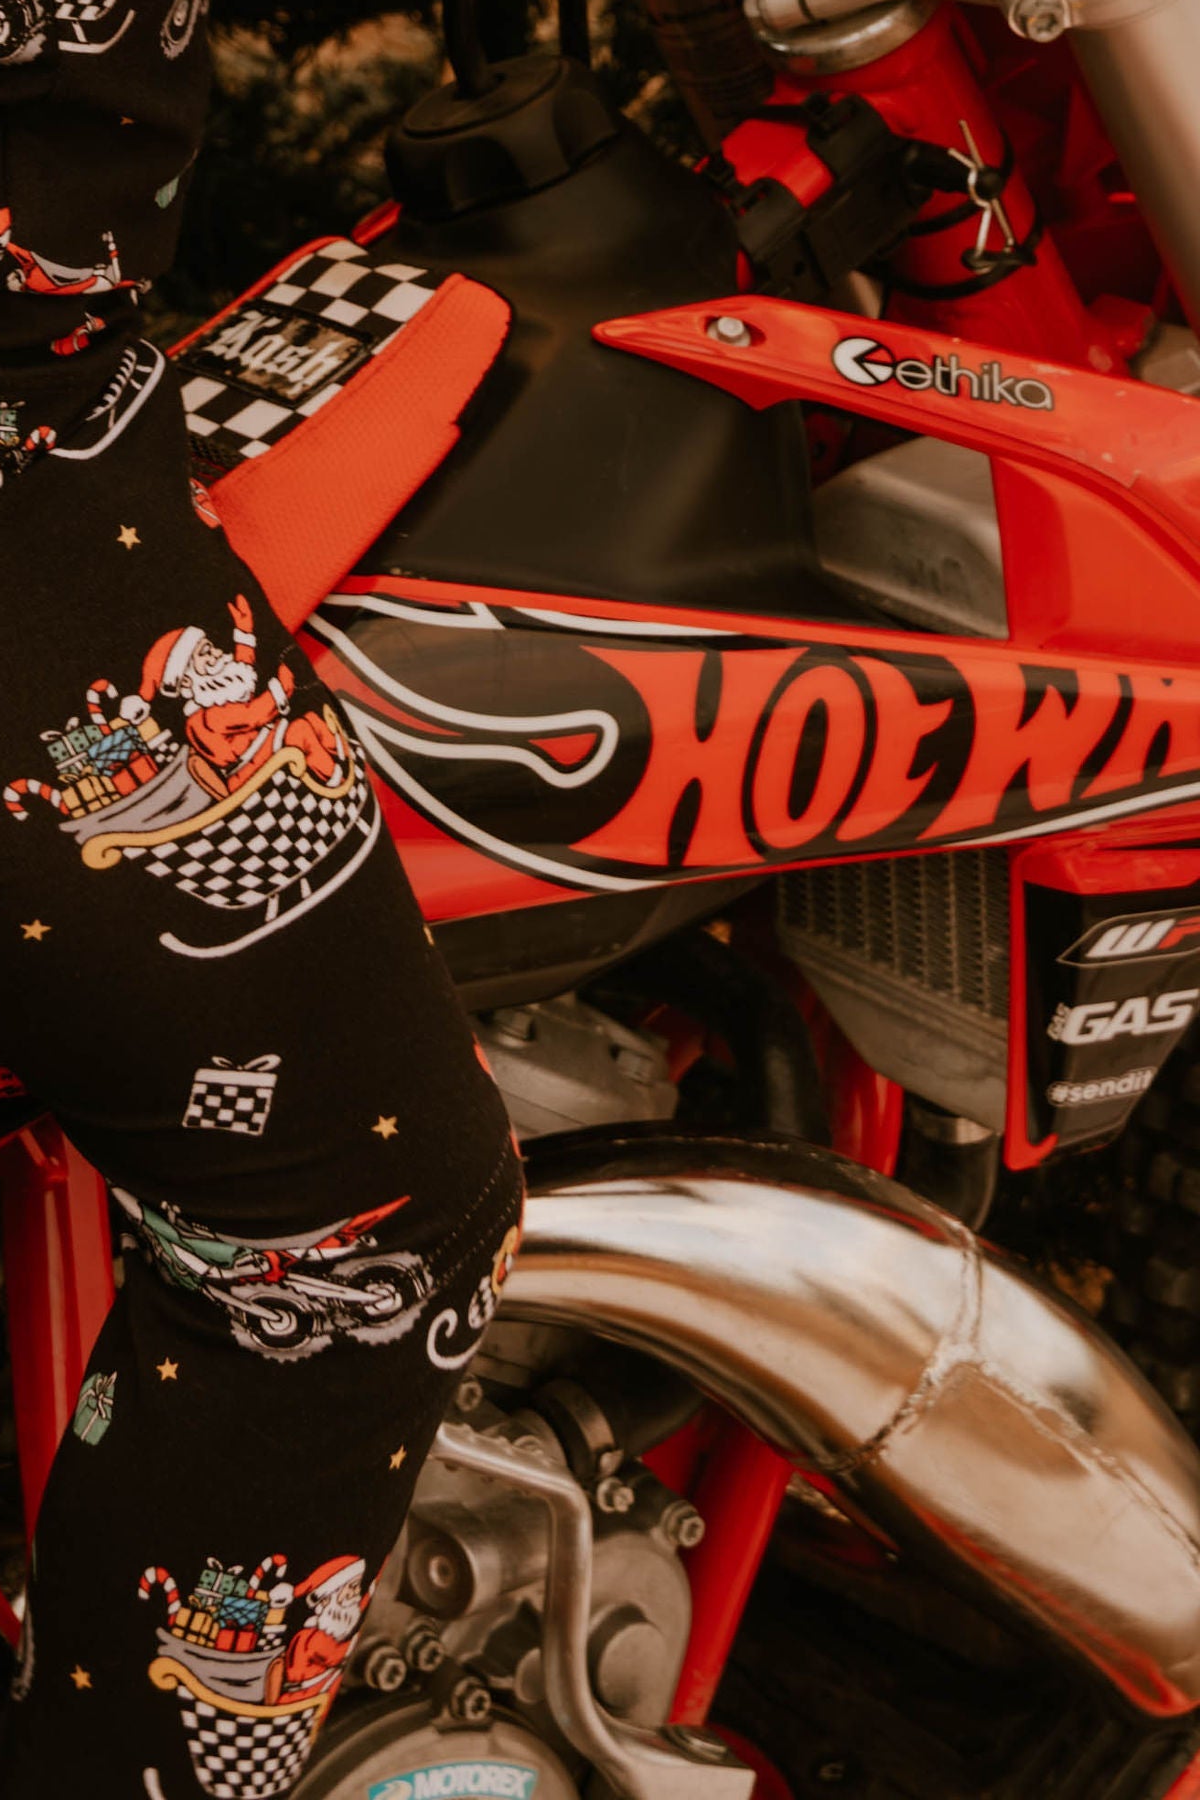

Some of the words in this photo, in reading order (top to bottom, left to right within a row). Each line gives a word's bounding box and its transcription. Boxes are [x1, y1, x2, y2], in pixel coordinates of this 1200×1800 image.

[895, 354, 1055, 412] ethika
[1062, 988, 1200, 1045] GAS
[413, 1764, 534, 1800] MOTOREX
